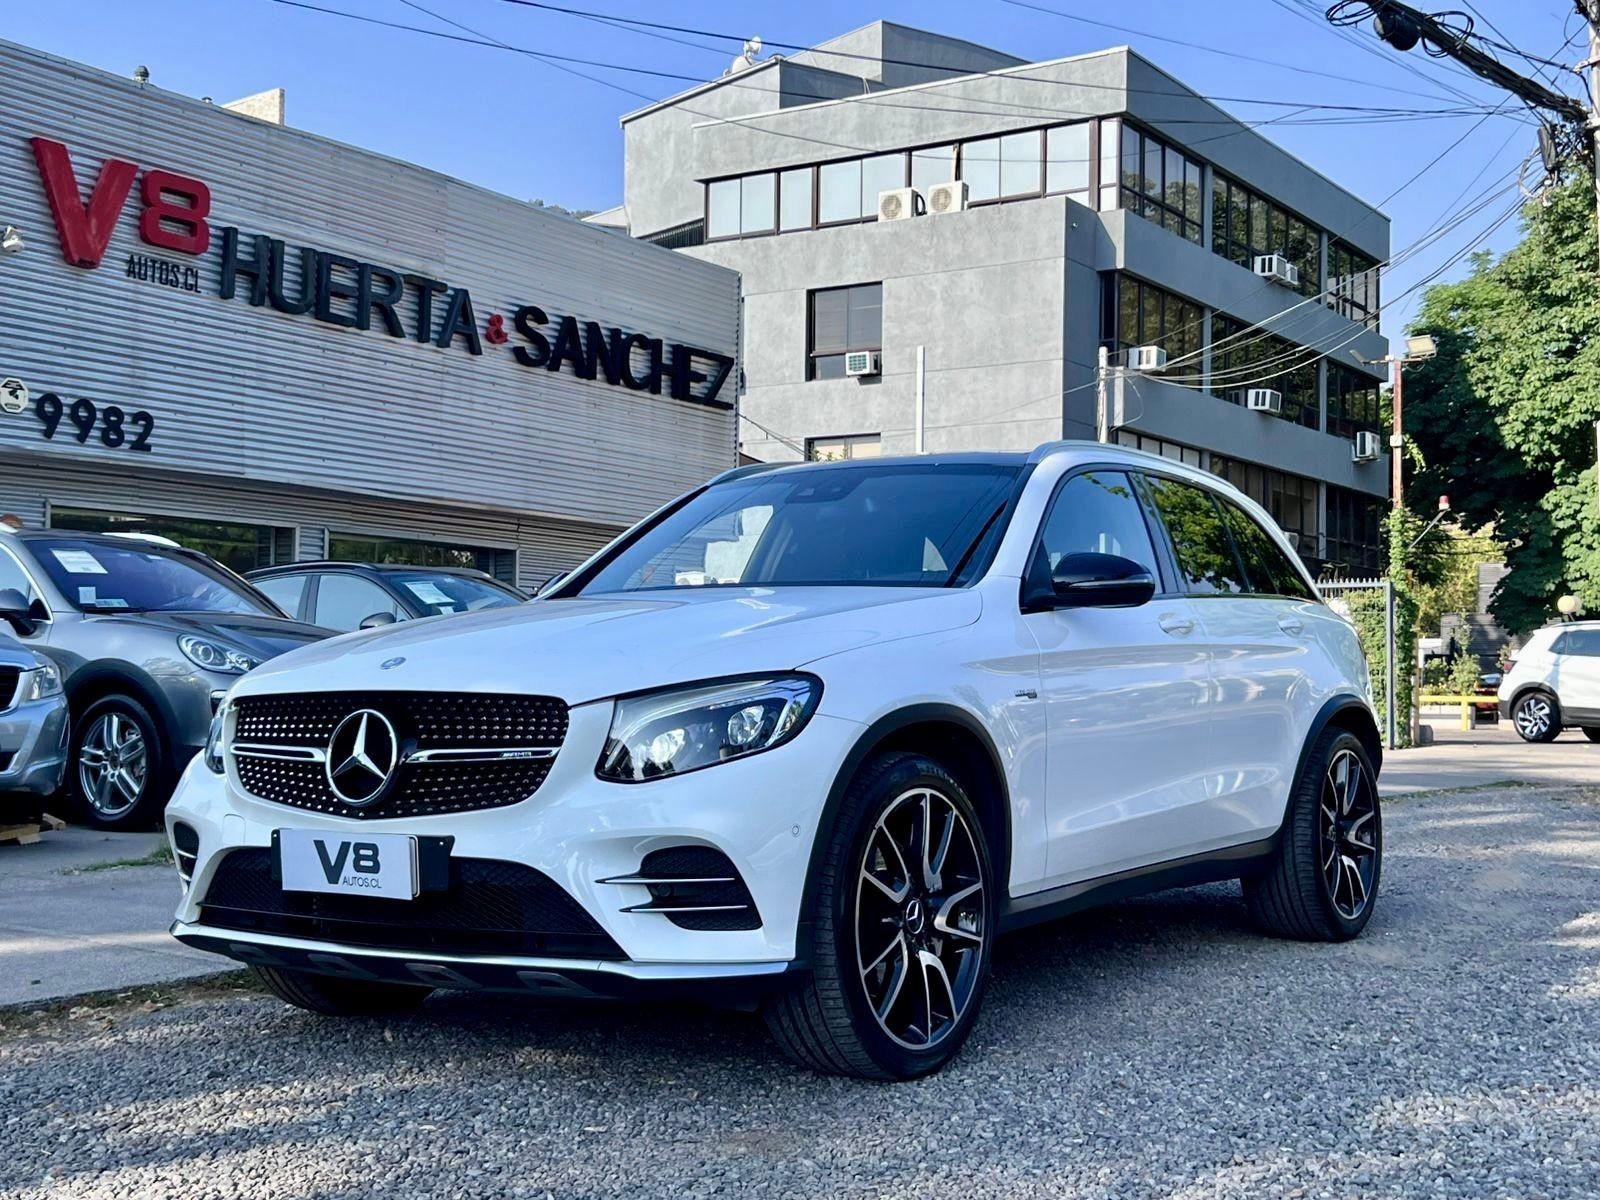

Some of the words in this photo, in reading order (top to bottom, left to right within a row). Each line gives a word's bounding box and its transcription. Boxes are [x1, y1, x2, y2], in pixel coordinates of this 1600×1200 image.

[29, 136, 211, 269] V8
[126, 254, 202, 293] AUTOS.CL
[220, 226, 482, 355] HUERTA
[485, 314, 508, 345] &
[512, 305, 735, 410] SANCHEZ
[35, 392, 154, 452] 9982
[313, 839, 381, 885] V8
[342, 876, 382, 889] AUTOS.CL
